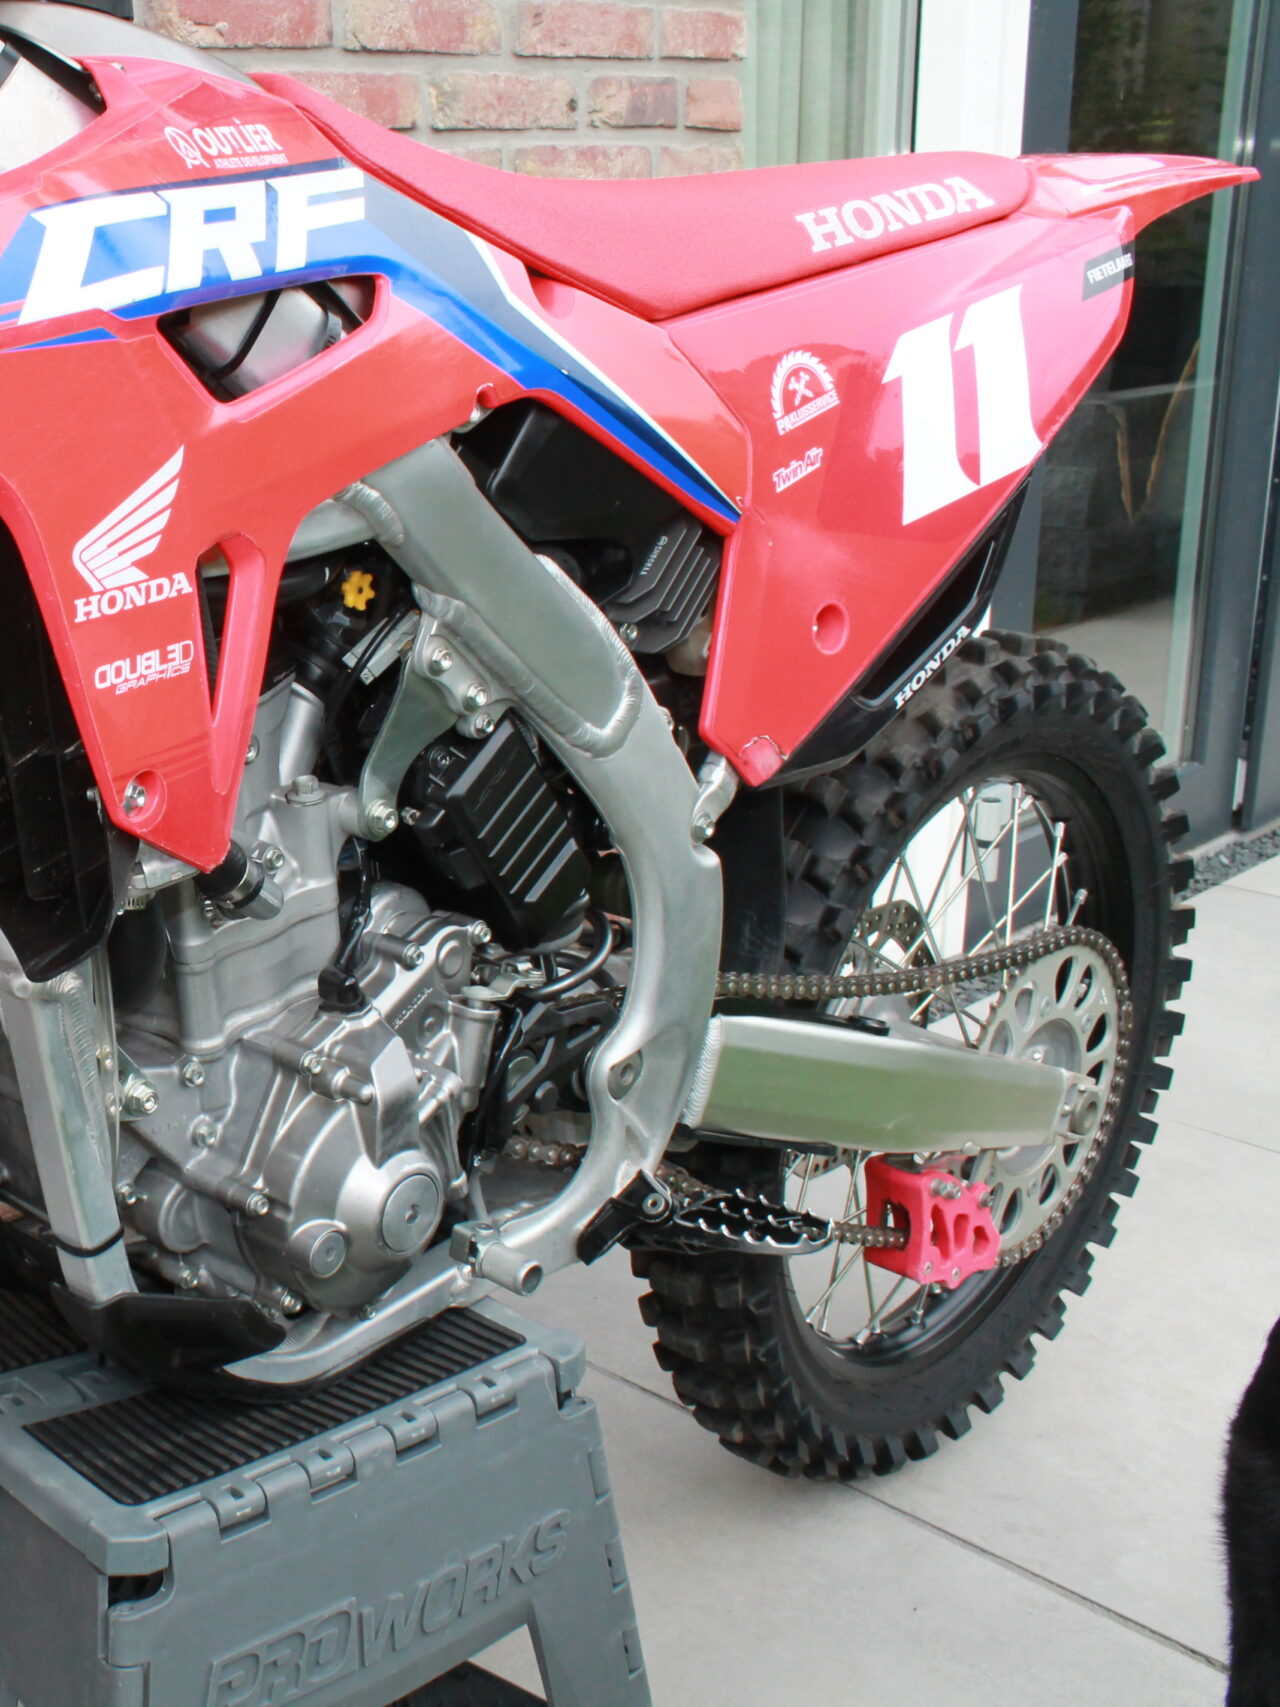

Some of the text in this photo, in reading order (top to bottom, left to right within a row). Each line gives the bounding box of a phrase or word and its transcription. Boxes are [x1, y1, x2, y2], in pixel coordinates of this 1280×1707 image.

[17, 167, 365, 325] CRF
[795, 176, 995, 252] HONDA
[881, 283, 1045, 526] 11
[74, 571, 193, 623] HONDA
[115, 662, 191, 695] GRAPHICS
[894, 625, 971, 710] HONDA
[209, 1507, 570, 1707] PROWORKS
